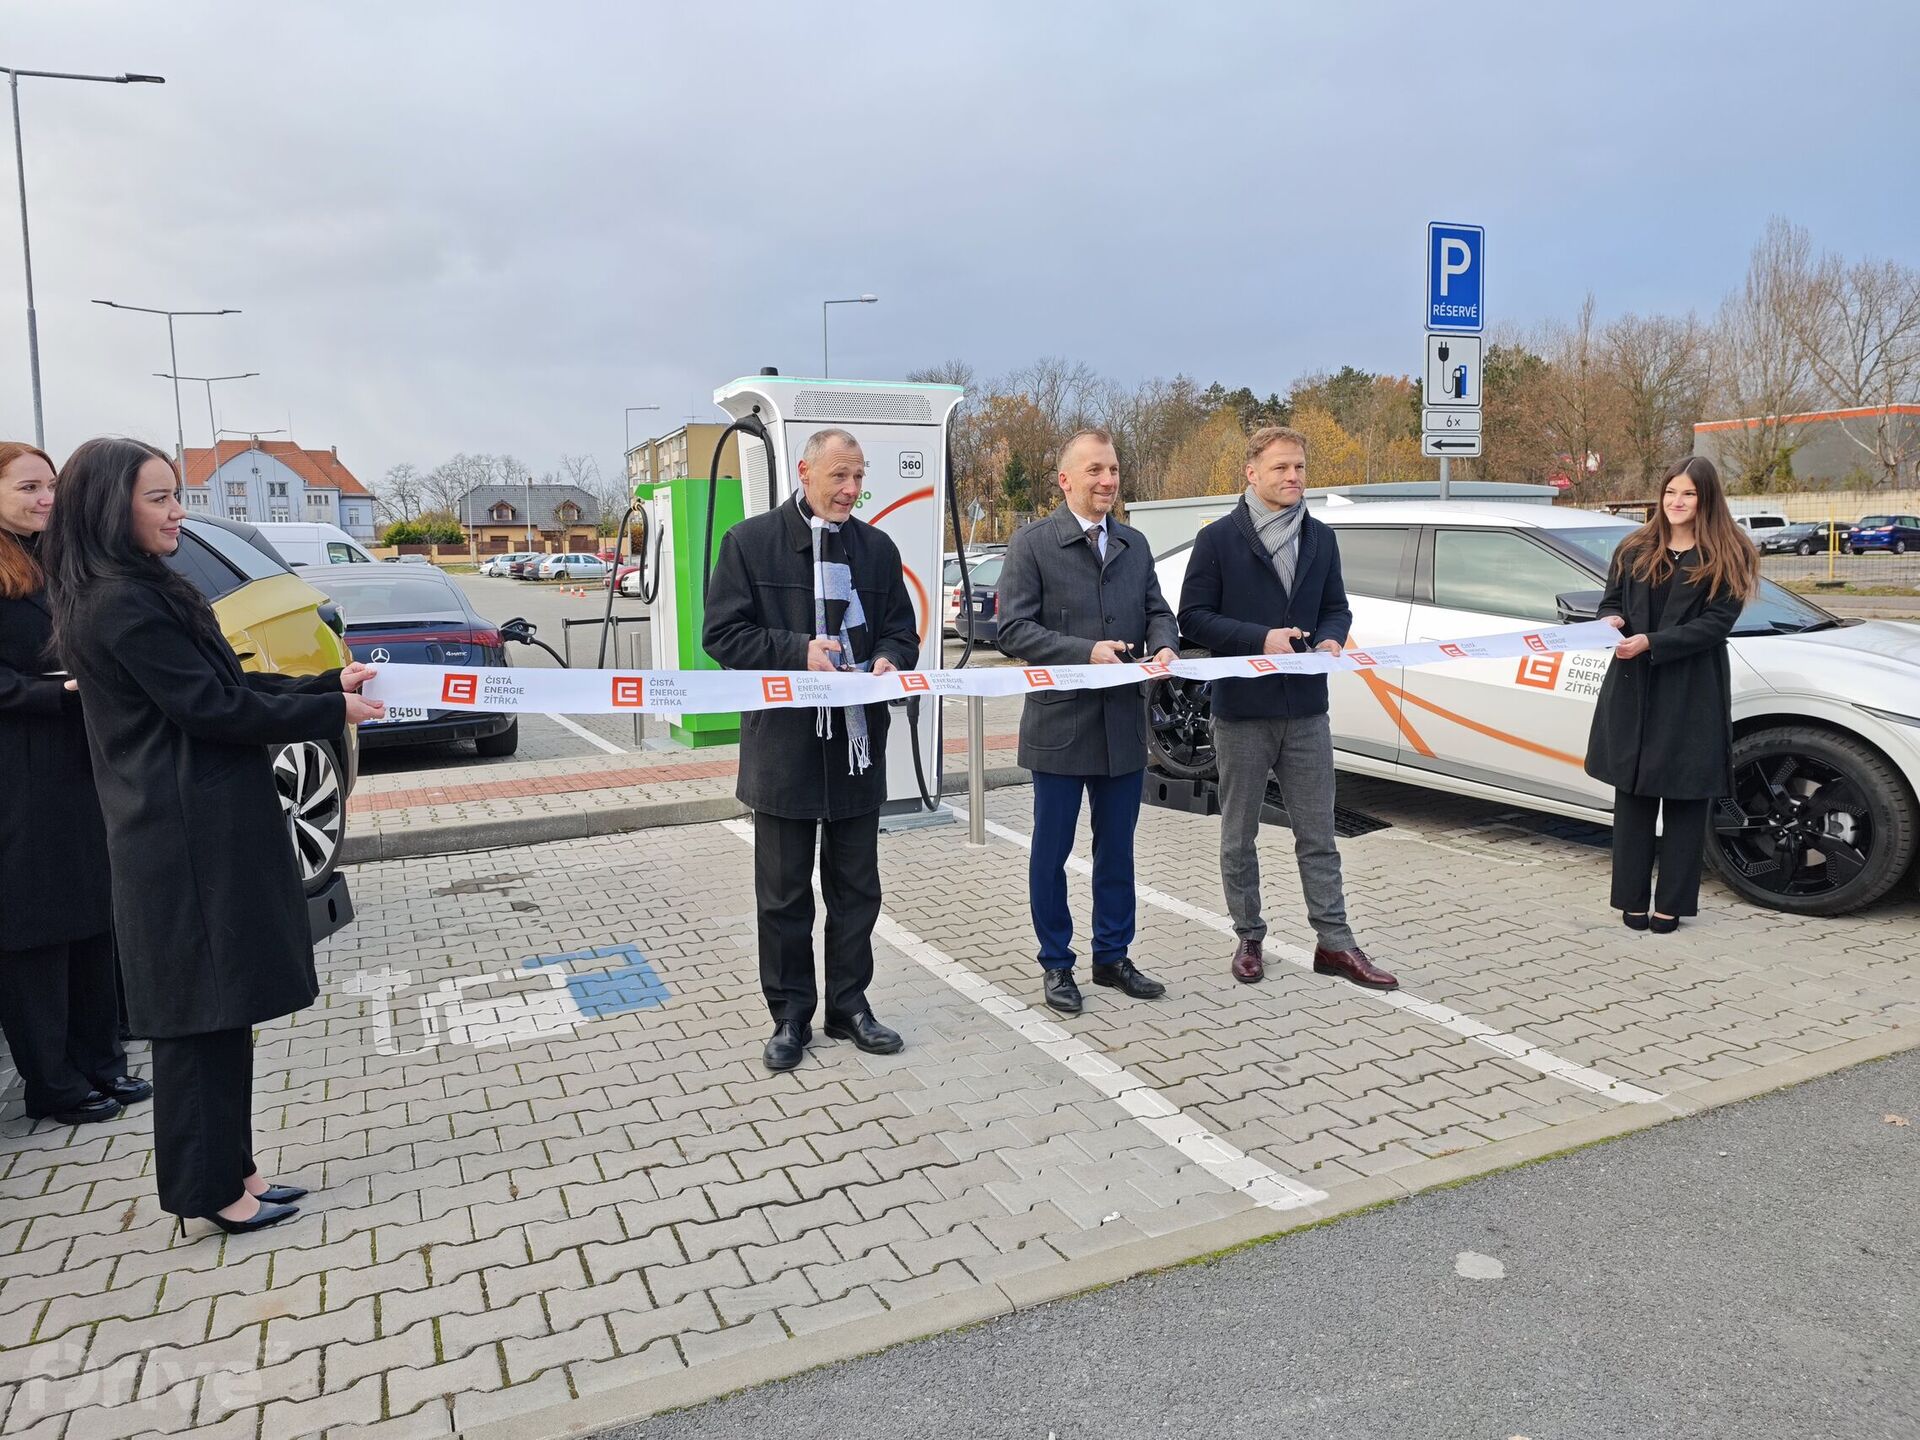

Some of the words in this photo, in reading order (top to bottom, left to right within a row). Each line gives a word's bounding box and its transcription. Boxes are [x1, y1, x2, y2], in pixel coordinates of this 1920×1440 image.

[1440, 237, 1472, 296] P
[1433, 303, 1478, 318] RÉSERVÉ
[901, 460, 921, 470] 360
[1572, 654, 1607, 670] ČISTÁ
[485, 675, 513, 685] ČISTÁ
[649, 677, 675, 687] ČISTÁ
[483, 685, 525, 695] ENERGIE
[649, 688, 688, 697] ENERGIE
[797, 684, 833, 692] ENERGIE
[483, 695, 519, 705] ZÍTŘKA
[799, 692, 829, 700] ZÍTŘKA
[650, 697, 683, 706] ZÍTŘKA
